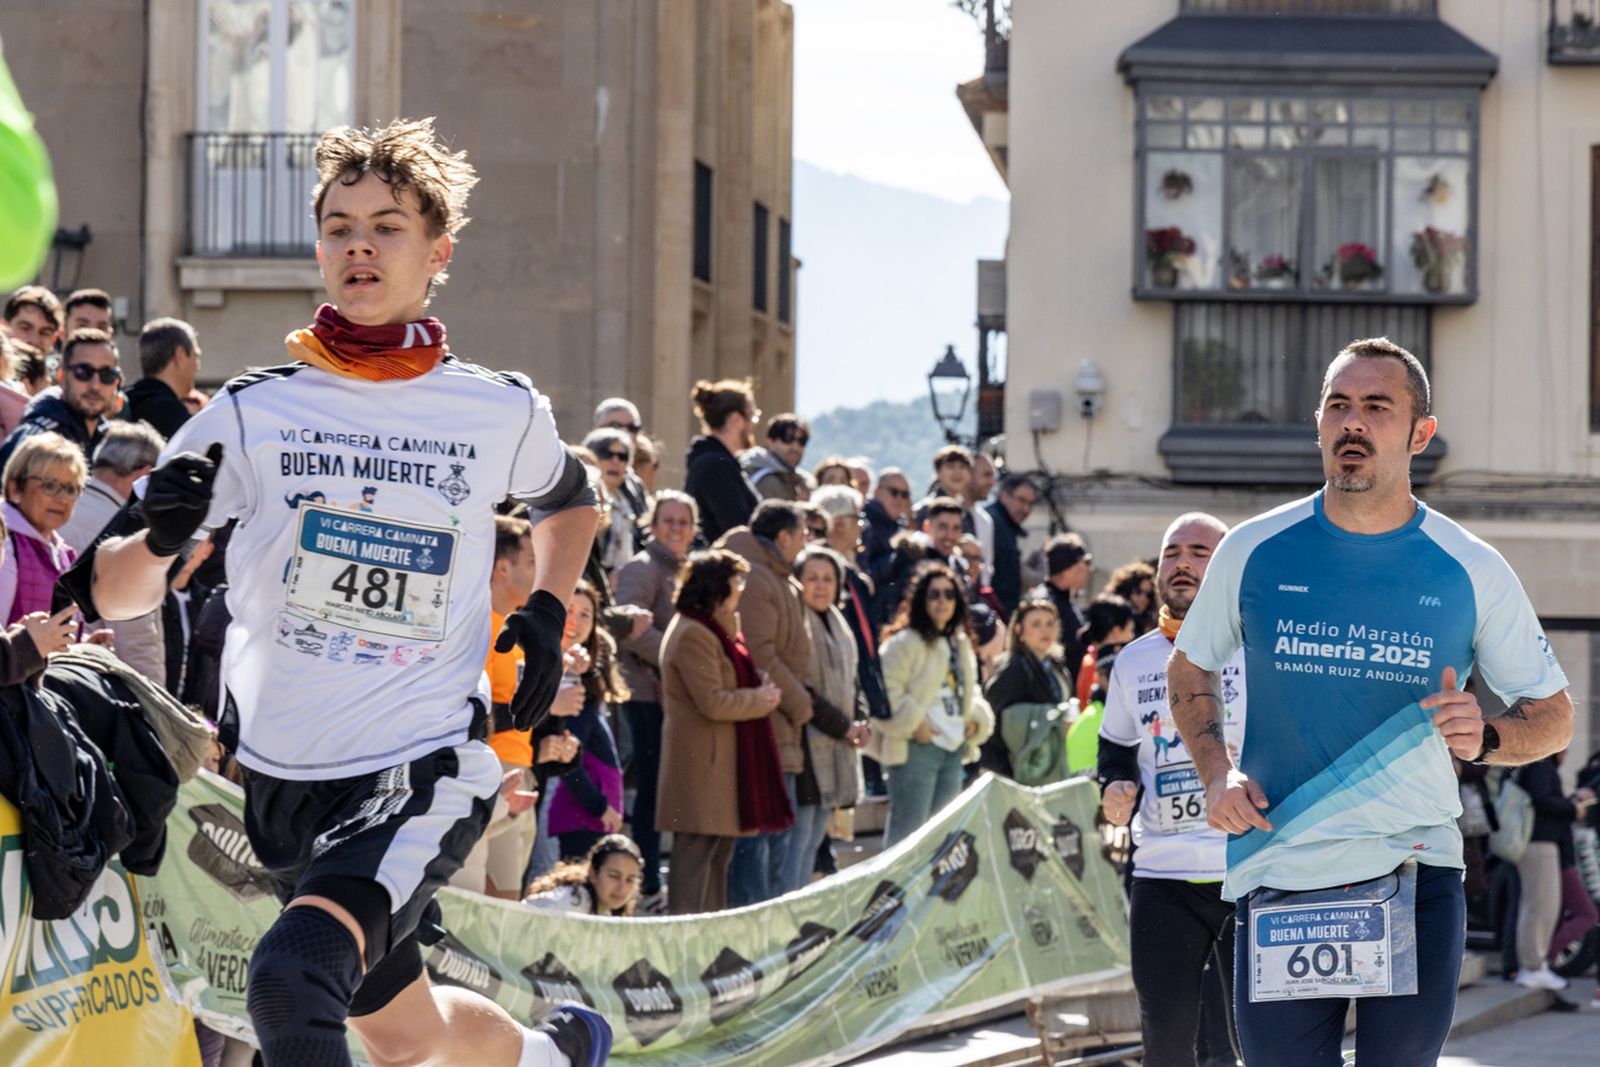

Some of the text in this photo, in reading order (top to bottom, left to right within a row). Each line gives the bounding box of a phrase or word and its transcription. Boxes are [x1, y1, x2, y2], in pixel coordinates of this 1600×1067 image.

[280, 428, 476, 460] VI CARRERA CAMINATA
[280, 452, 437, 488] BUENA MUERTE
[320, 517, 439, 547] VI CARRERA CAMINATA
[316, 532, 412, 566] BUENA MUERTE
[331, 563, 408, 612] 481
[1276, 619, 1434, 649] Medio Maratón
[1274, 636, 1431, 669] Almería 2025
[1275, 661, 1430, 686] RAMÓN RUIZ ANDÚJAR
[1172, 794, 1207, 820] 56
[1270, 910, 1370, 925] VI CARRERA CAMINATA
[1270, 924, 1350, 942] BUENA MUERTE
[208, 950, 249, 994] VERD
[1287, 943, 1353, 978] 601
